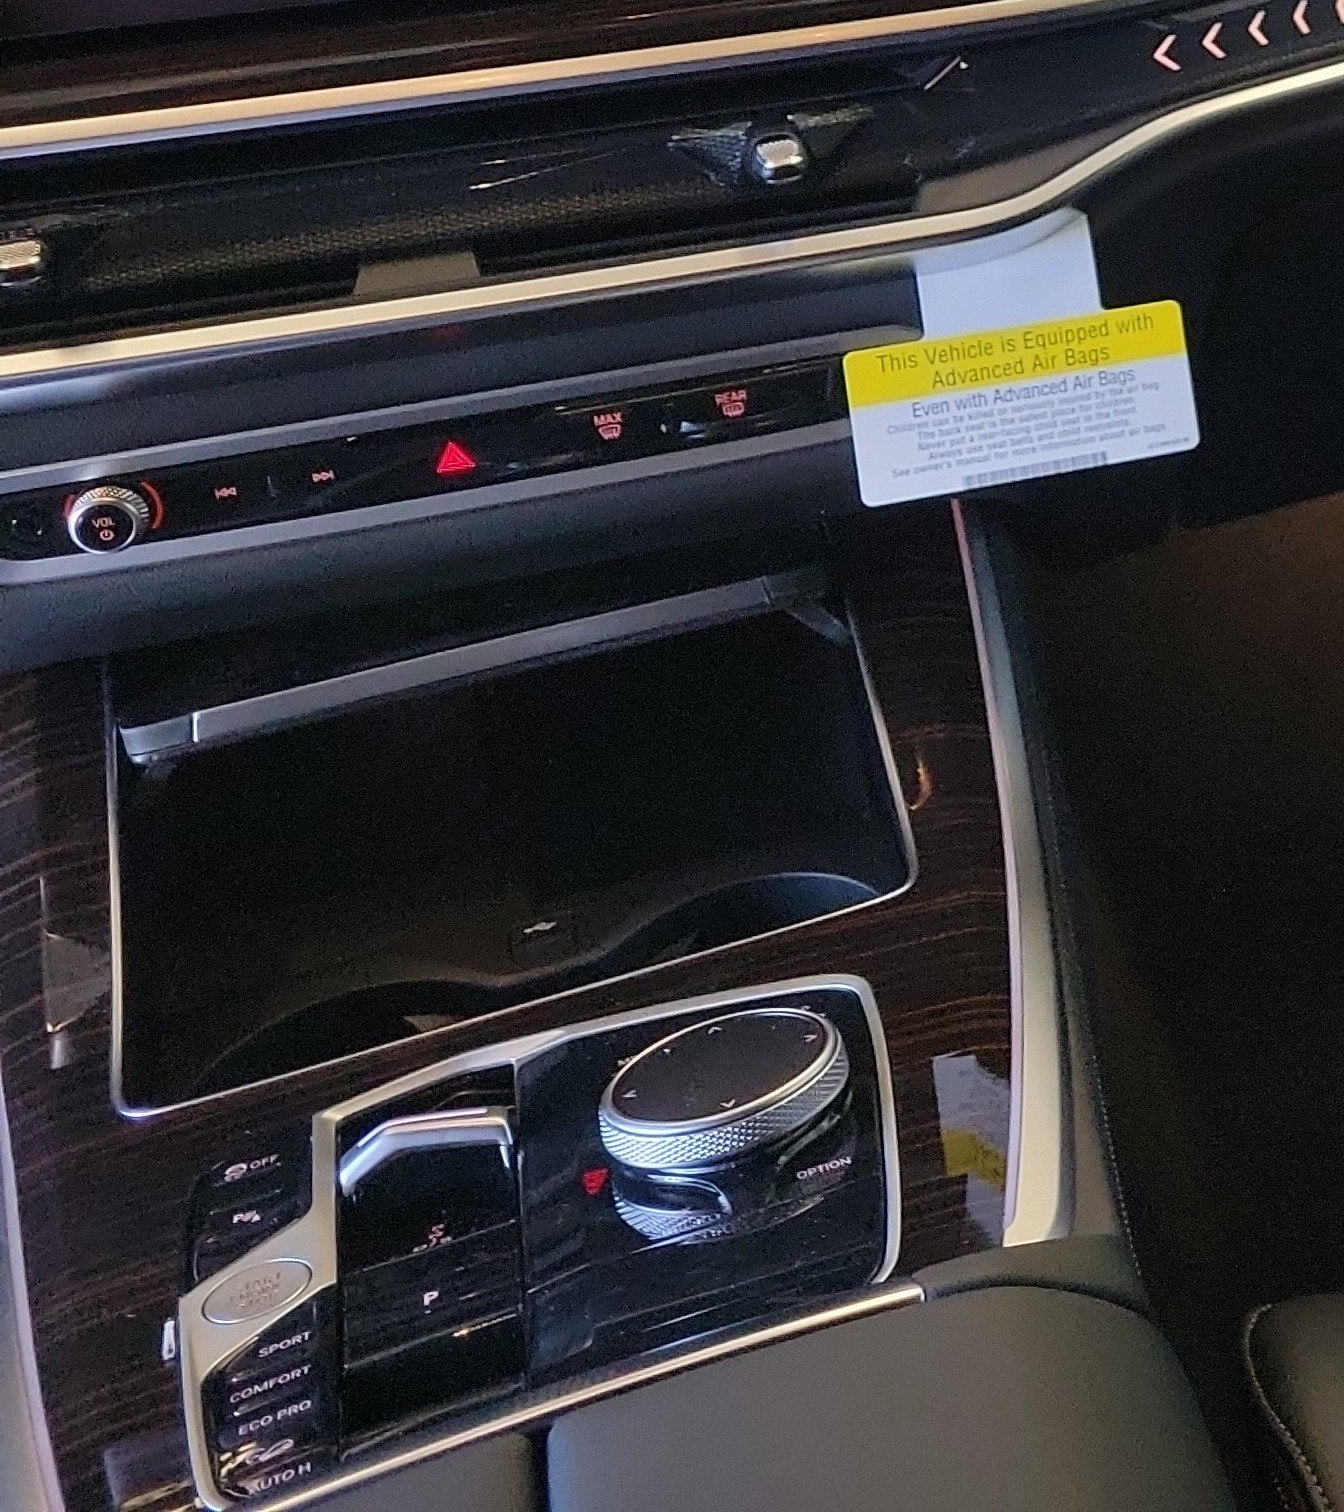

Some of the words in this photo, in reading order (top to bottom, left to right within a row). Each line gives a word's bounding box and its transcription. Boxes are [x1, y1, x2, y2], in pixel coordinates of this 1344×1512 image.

[876, 352, 917, 373] This
[924, 339, 993, 365] Vehicle
[1001, 334, 1016, 352] is
[1023, 320, 1109, 350] Equipped
[1115, 313, 1154, 333] with
[932, 357, 1024, 388] Advanced
[1032, 351, 1056, 372] Air
[1066, 345, 1110, 367] Bags
[913, 399, 949, 417] Even
[954, 392, 988, 412] with
[994, 376, 1068, 404] Advanced
[1073, 371, 1093, 389] Air
[1099, 368, 1135, 389] Bags
[92, 517, 116, 528] VOL
[796, 1156, 852, 1180] OPTION
[423, 1290, 439, 1306] P
[258, 1331, 312, 1358] SPORT
[229, 1365, 312, 1404] COMFORT
[238, 1415, 273, 1436] ECO
[277, 1400, 312, 1421] PRO
[298, 1462, 312, 1475] H
